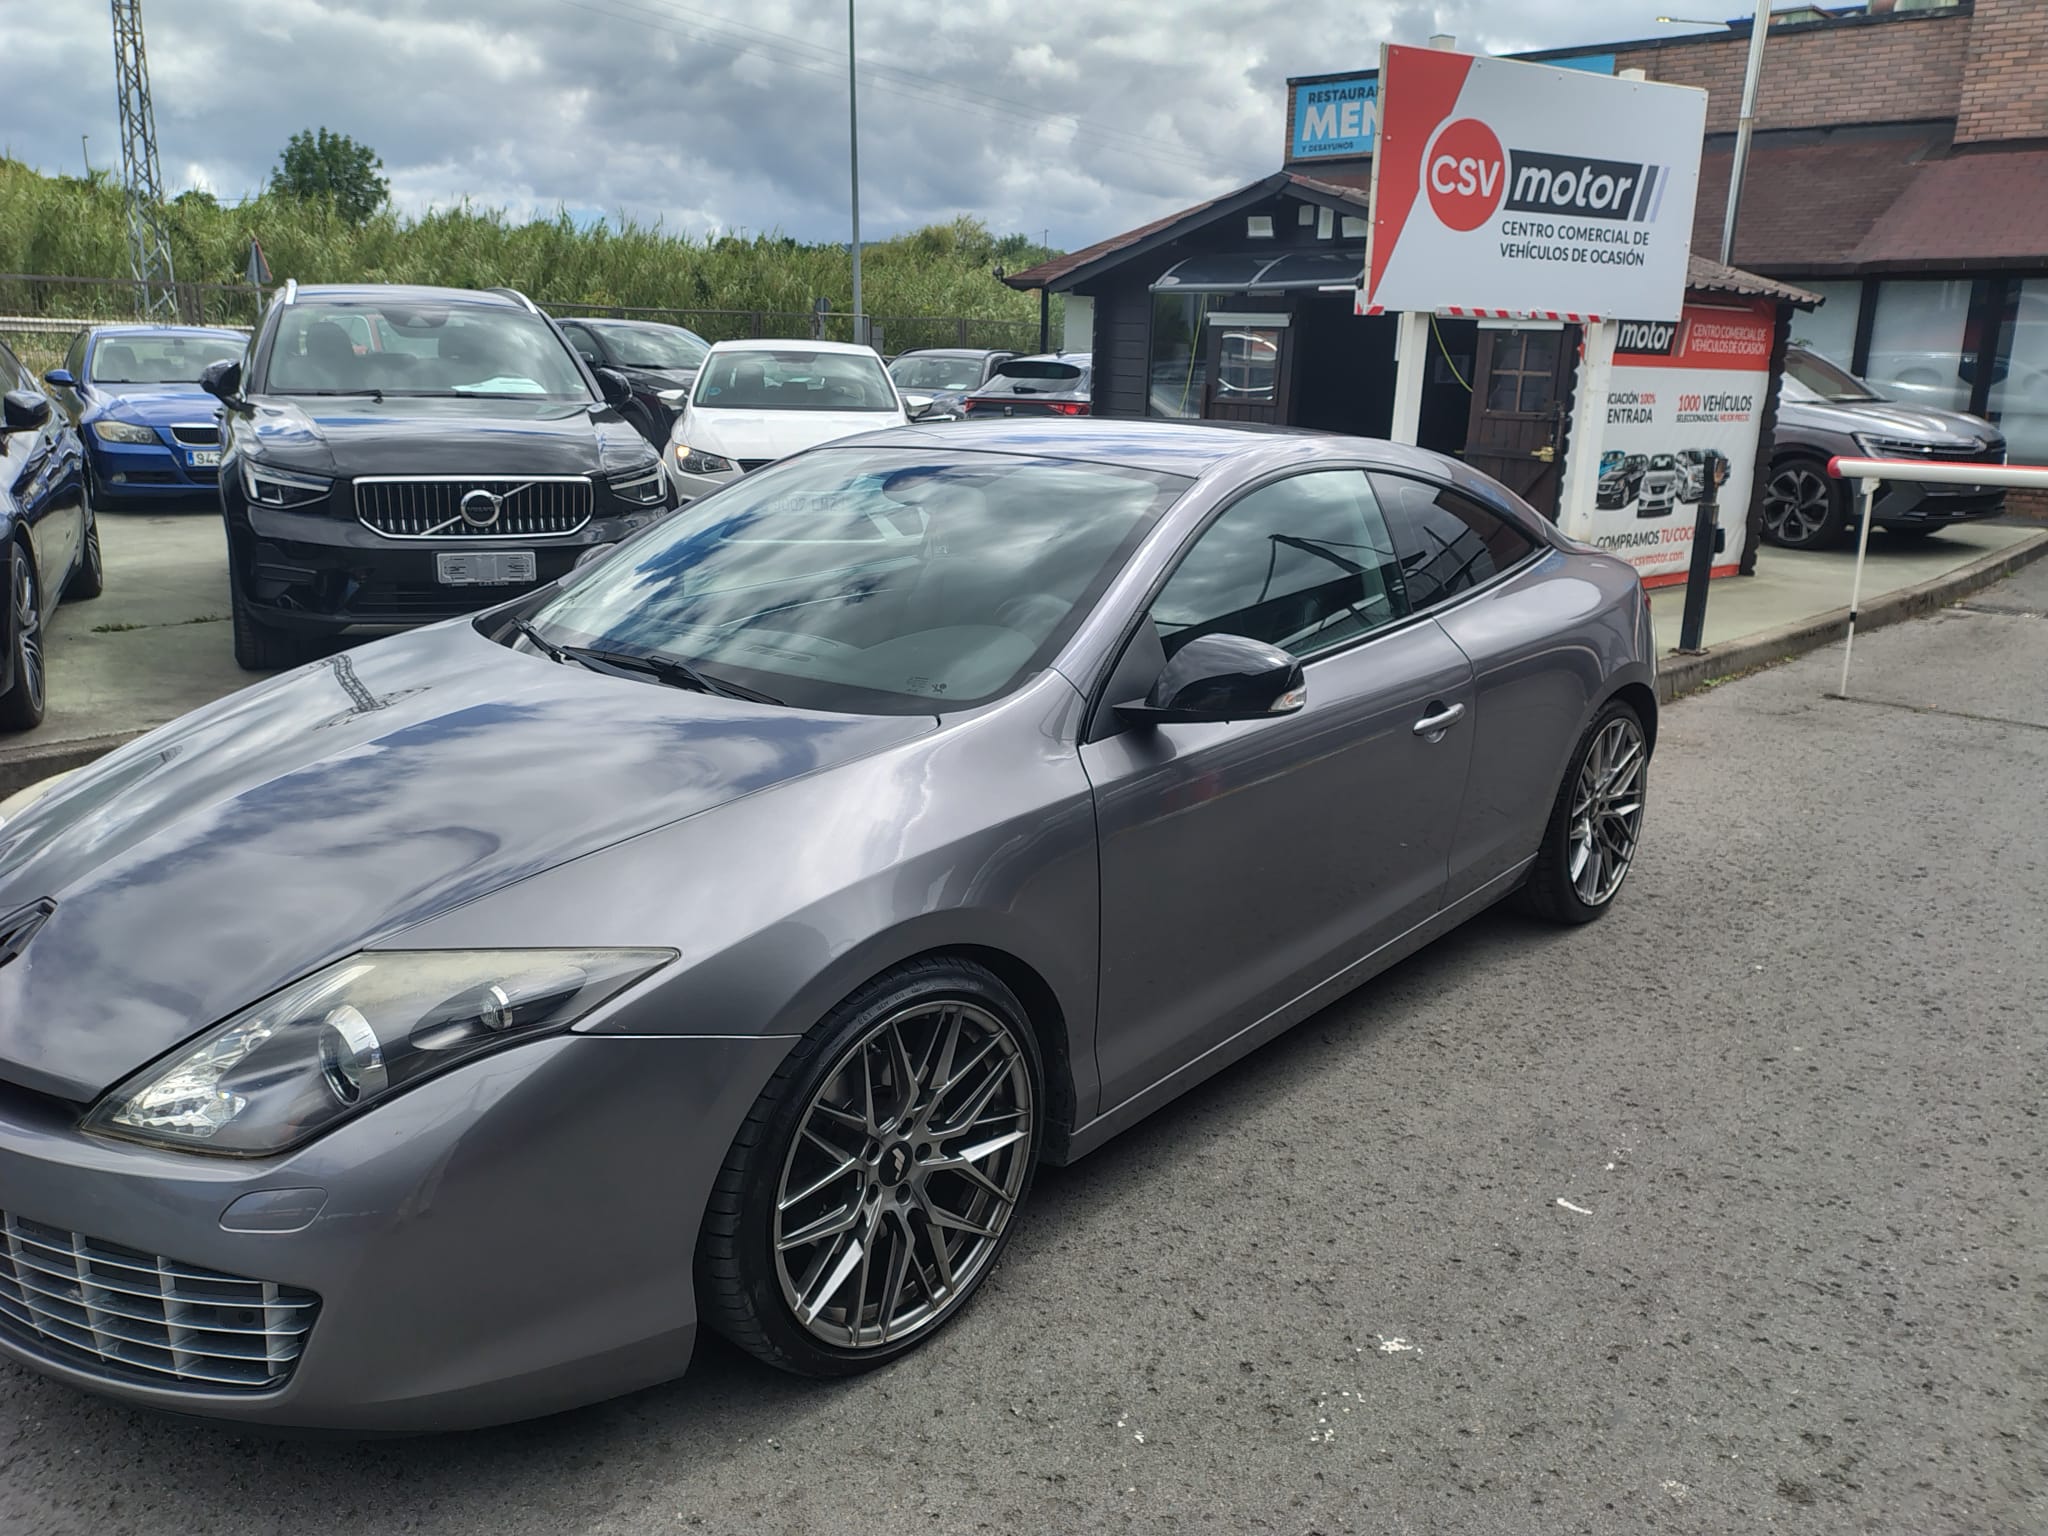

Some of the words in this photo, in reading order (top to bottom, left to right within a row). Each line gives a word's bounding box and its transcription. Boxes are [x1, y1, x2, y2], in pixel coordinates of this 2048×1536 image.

[1302, 145, 1307, 153] Y
[1308, 141, 1354, 152] DESAYUNOS
[1431, 154, 1502, 198] CSV
[1513, 165, 1633, 210] motor
[1502, 221, 1555, 239] CENTRO
[1557, 224, 1631, 245] COMERCIAL
[1633, 231, 1651, 246] DE
[1500, 240, 1569, 262] VEHÍCULOS
[1571, 247, 1588, 263] DE
[1590, 249, 1645, 267] OCASIÓN
[1618, 321, 1675, 350] motor
[1693, 324, 1720, 338] CENTRO
[1721, 325, 1756, 341] COMERCIAL
[1757, 328, 1767, 341] DE
[1691, 337, 1728, 353] VEHÍCULOS
[1728, 341, 1738, 353] DE
[1739, 341, 1766, 355] OCASIÓN
[1678, 394, 1702, 412] 1000
[1703, 391, 1753, 412] VEHÍCULOS
[1607, 407, 1653, 424] ENTRADA
[1596, 530, 1660, 549] COMPRAMOS
[1660, 527, 1674, 544] TU
